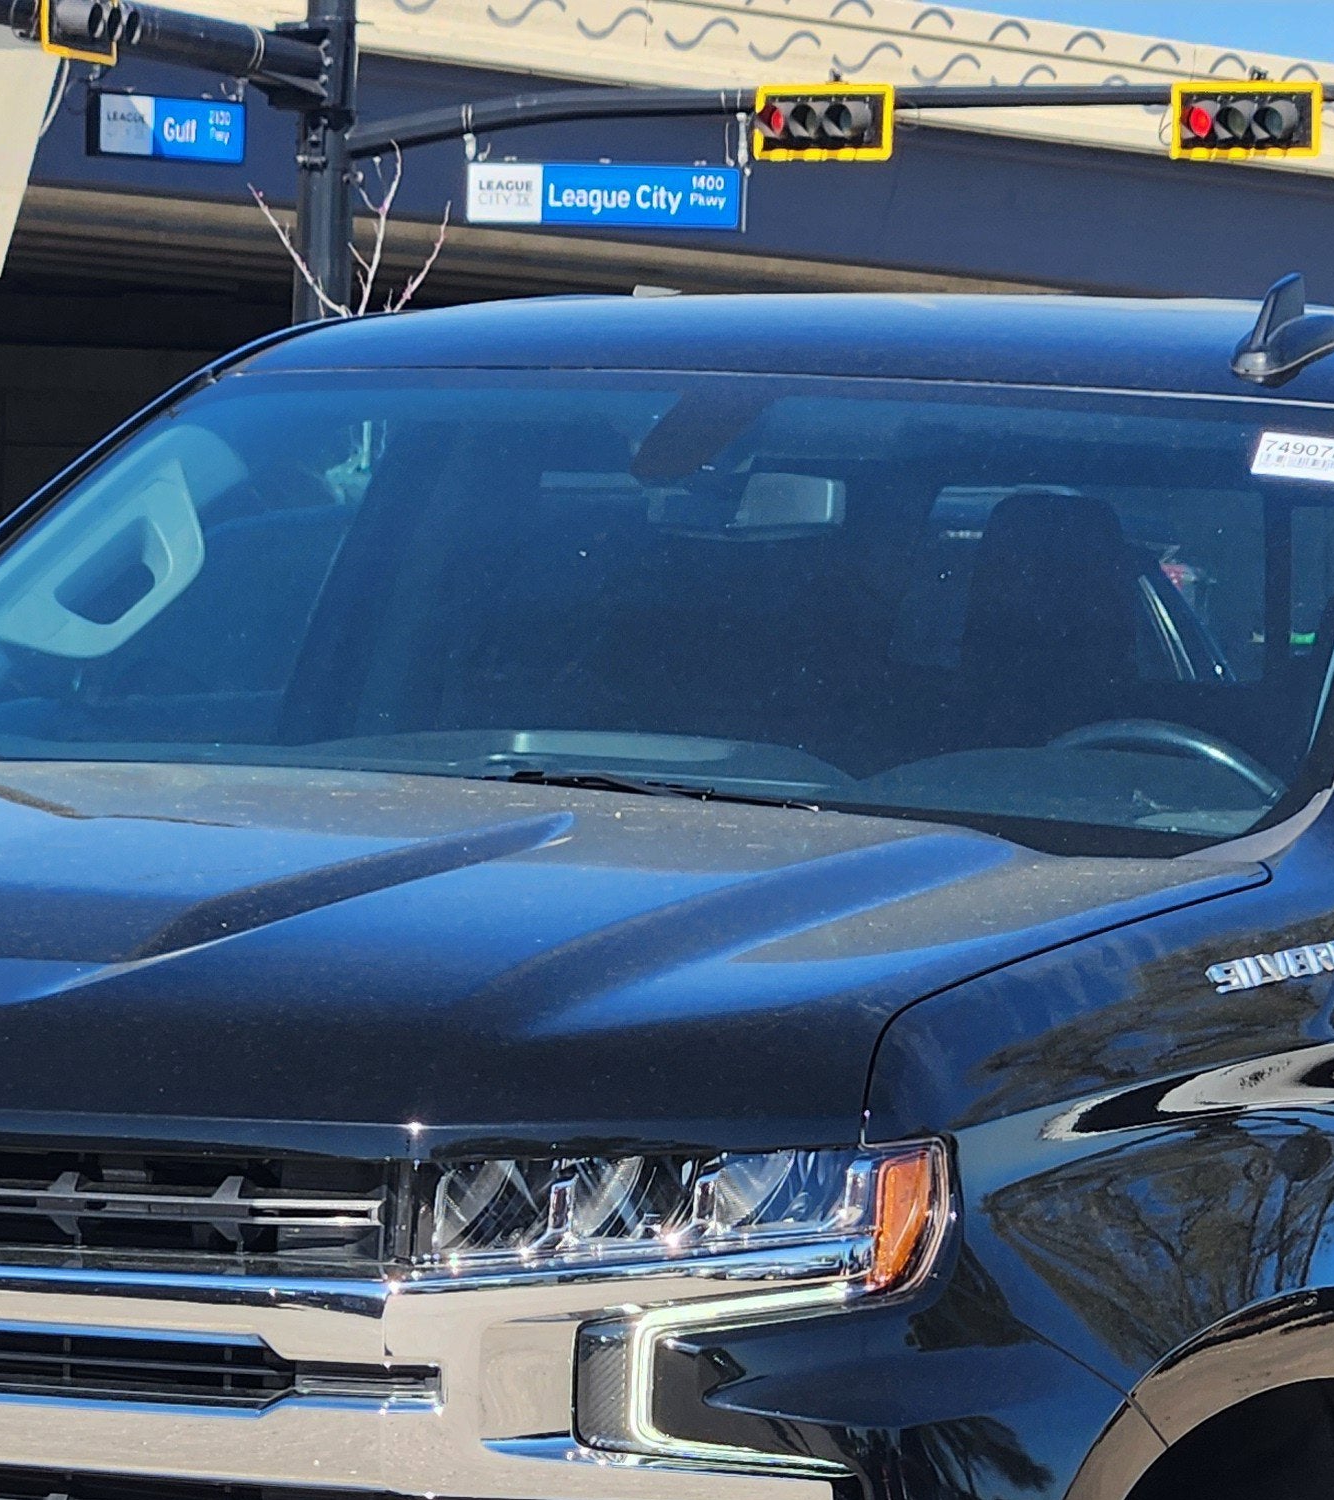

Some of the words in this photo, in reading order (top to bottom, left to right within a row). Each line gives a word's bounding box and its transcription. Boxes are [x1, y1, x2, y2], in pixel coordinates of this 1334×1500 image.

[163, 116, 197, 143] Gulf
[478, 179, 534, 192] LEAGUE
[691, 174, 725, 191] 1400
[548, 182, 631, 215] League
[635, 184, 683, 215] City
